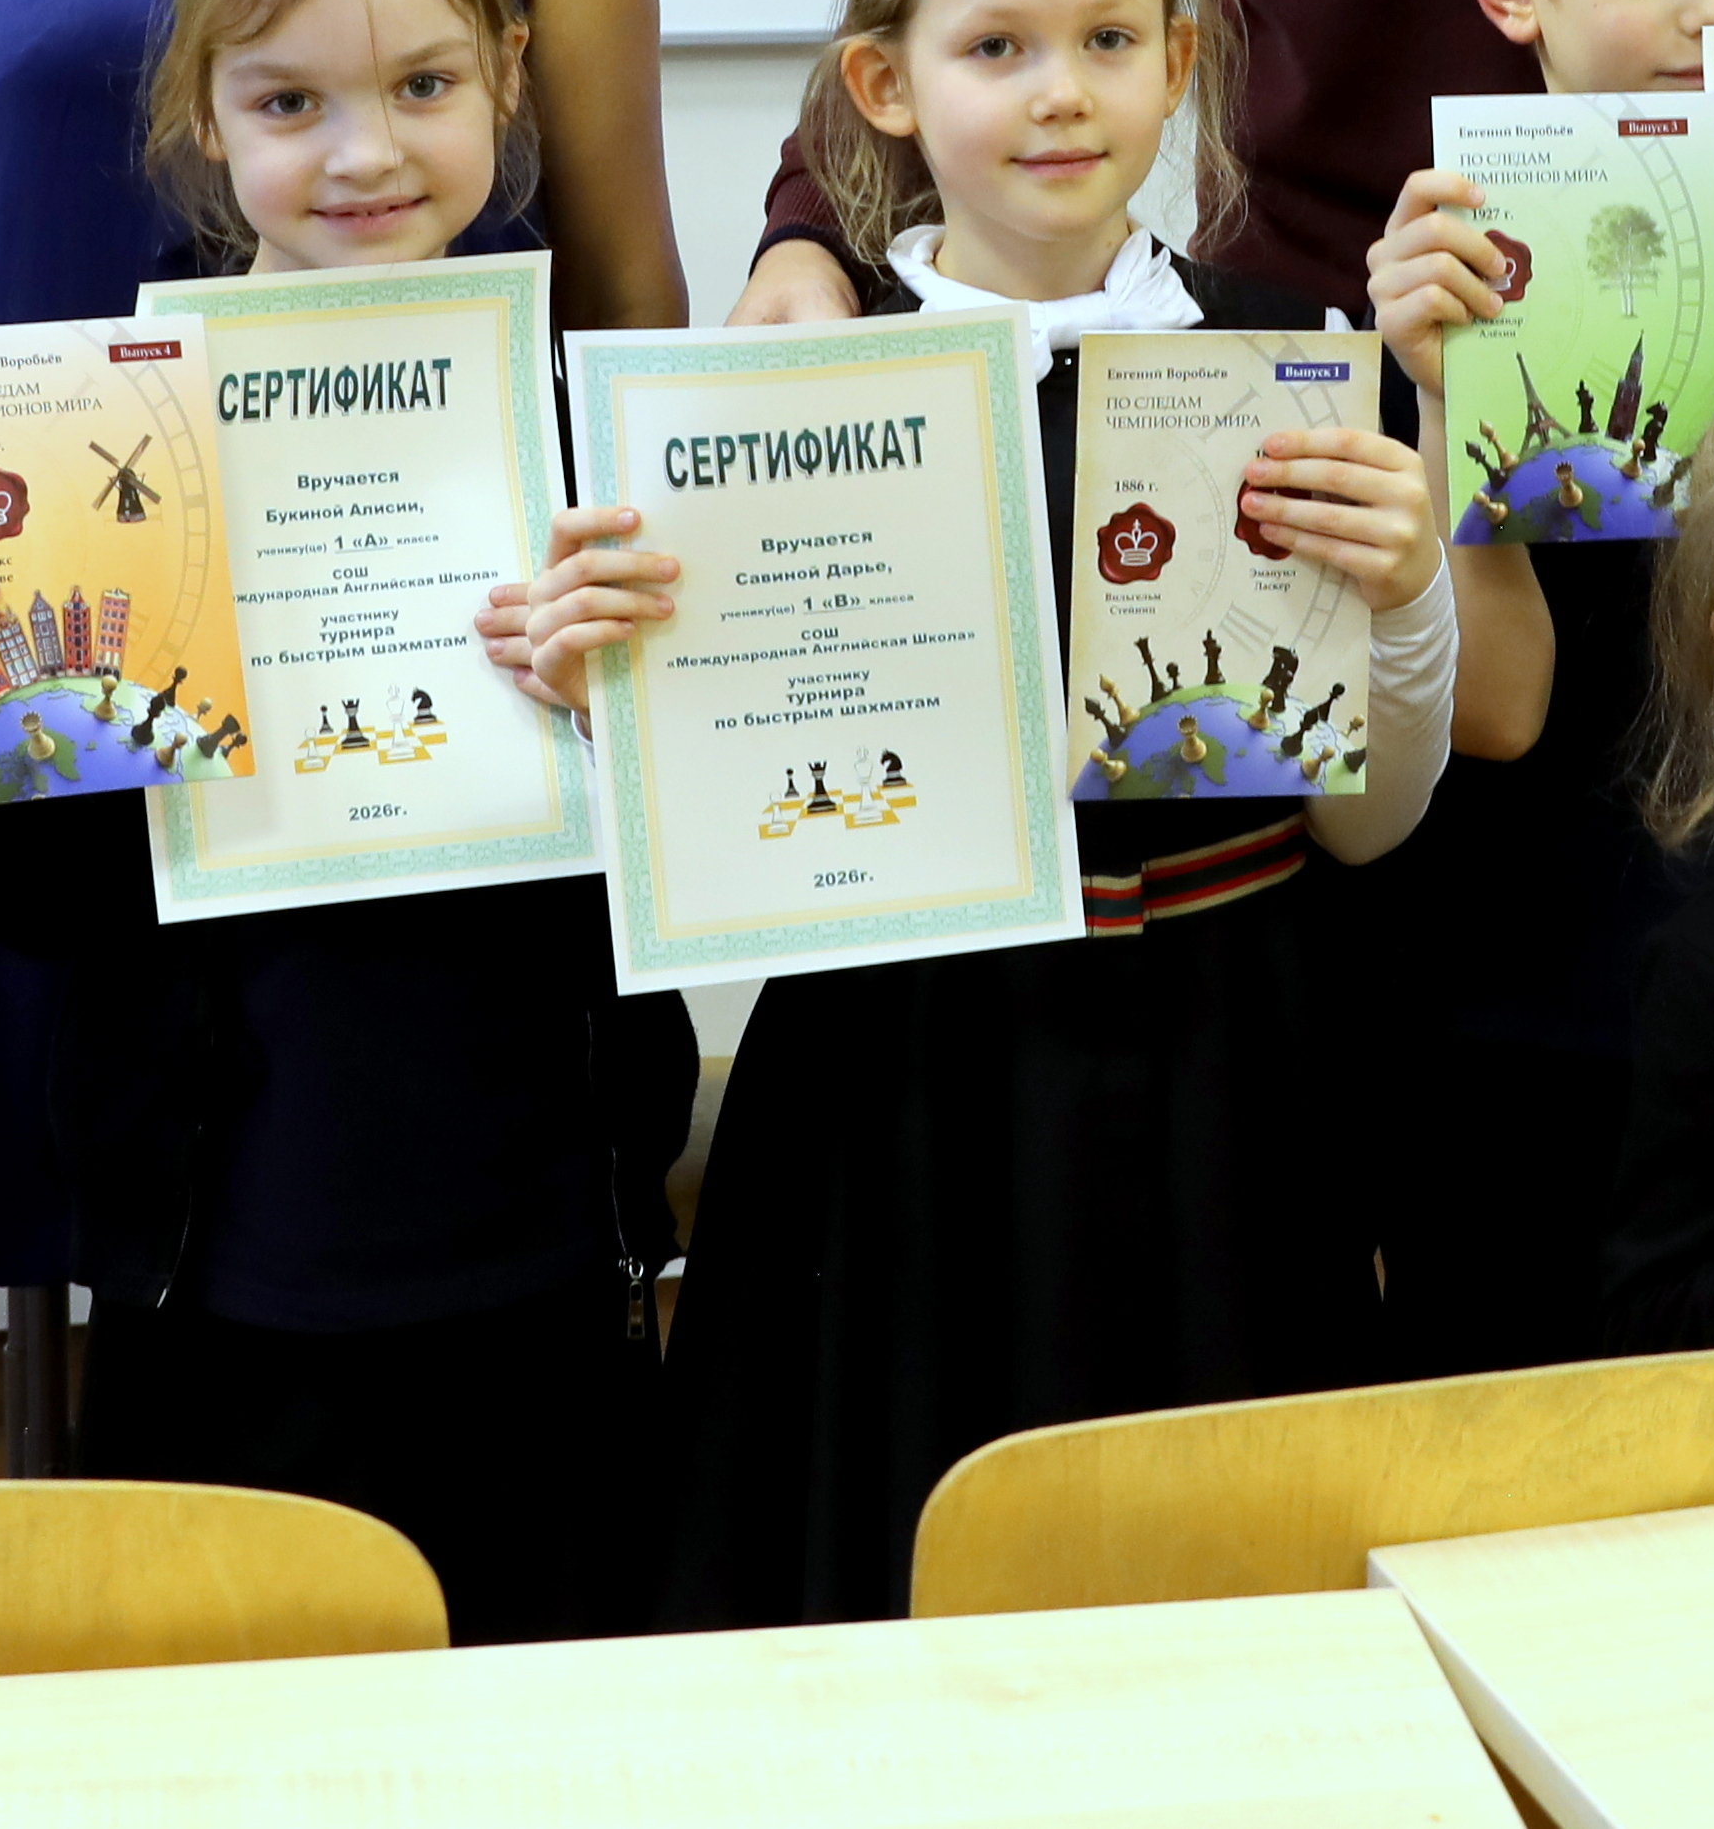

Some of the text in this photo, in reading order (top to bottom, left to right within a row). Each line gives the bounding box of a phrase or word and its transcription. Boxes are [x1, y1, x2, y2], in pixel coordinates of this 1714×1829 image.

[120, 347, 162, 358] Выпуск
[0, 355, 61, 370] Воробьёв
[219, 359, 451, 421] СЕРТИФИКАТ
[56, 398, 102, 412] МИРА
[666, 417, 925, 488] СЕРТИФИКАТ
[298, 472, 399, 491] Вручается
[267, 503, 423, 525] Букиной Алисии,
[762, 532, 872, 554] Вручается
[333, 567, 368, 579] СОШ
[344, 572, 498, 593] Английская Школа»
[736, 563, 891, 585] Савиной Дарье,
[321, 610, 398, 627] участнику
[320, 627, 394, 644] турнира
[801, 628, 838, 640] СОШ
[279, 636, 466, 663] быстрым шахматам
[668, 631, 974, 668] «Международная Английская Школа»
[788, 671, 869, 693] участнику
[787, 687, 866, 706] турнира
[744, 697, 939, 726] быстрым шахматам
[349, 804, 407, 821] 2026г.
[814, 870, 873, 887] 2026г.
